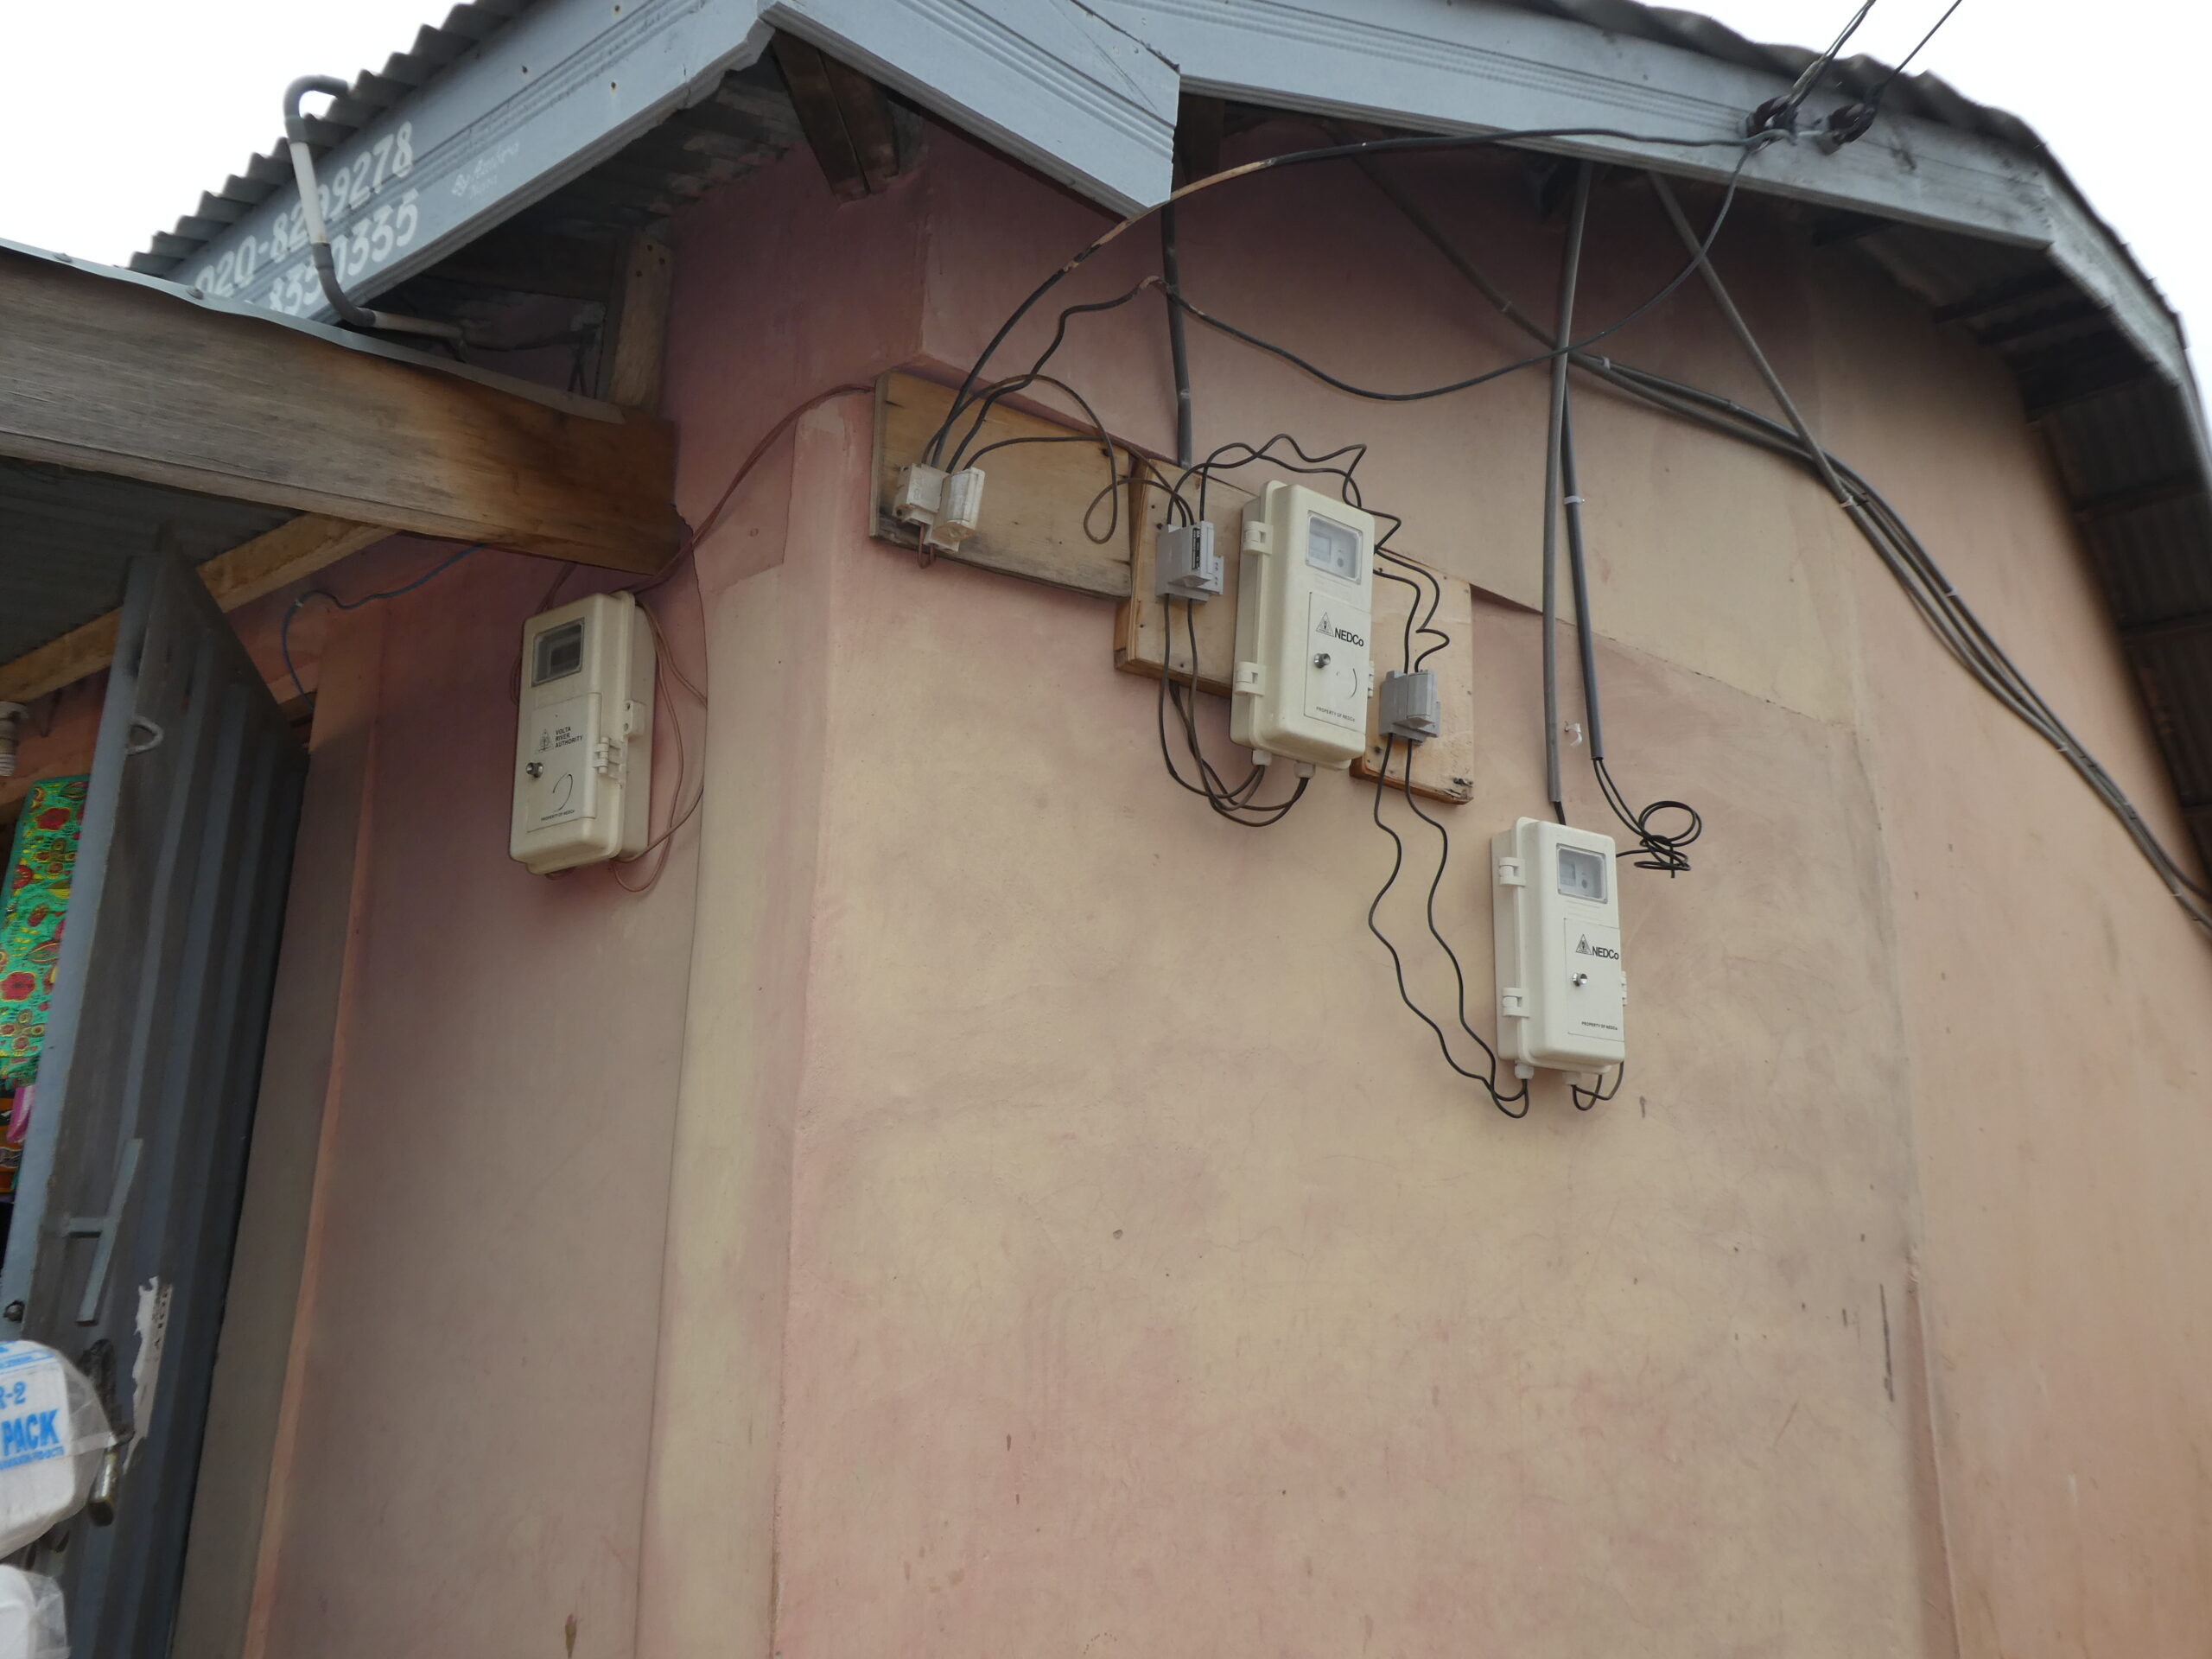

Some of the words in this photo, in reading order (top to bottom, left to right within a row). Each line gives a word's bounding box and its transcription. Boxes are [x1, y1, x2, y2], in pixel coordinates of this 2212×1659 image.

[1334, 627, 1364, 647] NEDCo
[556, 727, 571, 735] VOLTA
[556, 733, 570, 741] RIVER
[556, 735, 583, 747] AUTHORITY
[1592, 946, 1619, 960] NEDCo
[2, 1408, 60, 1458] PACK
